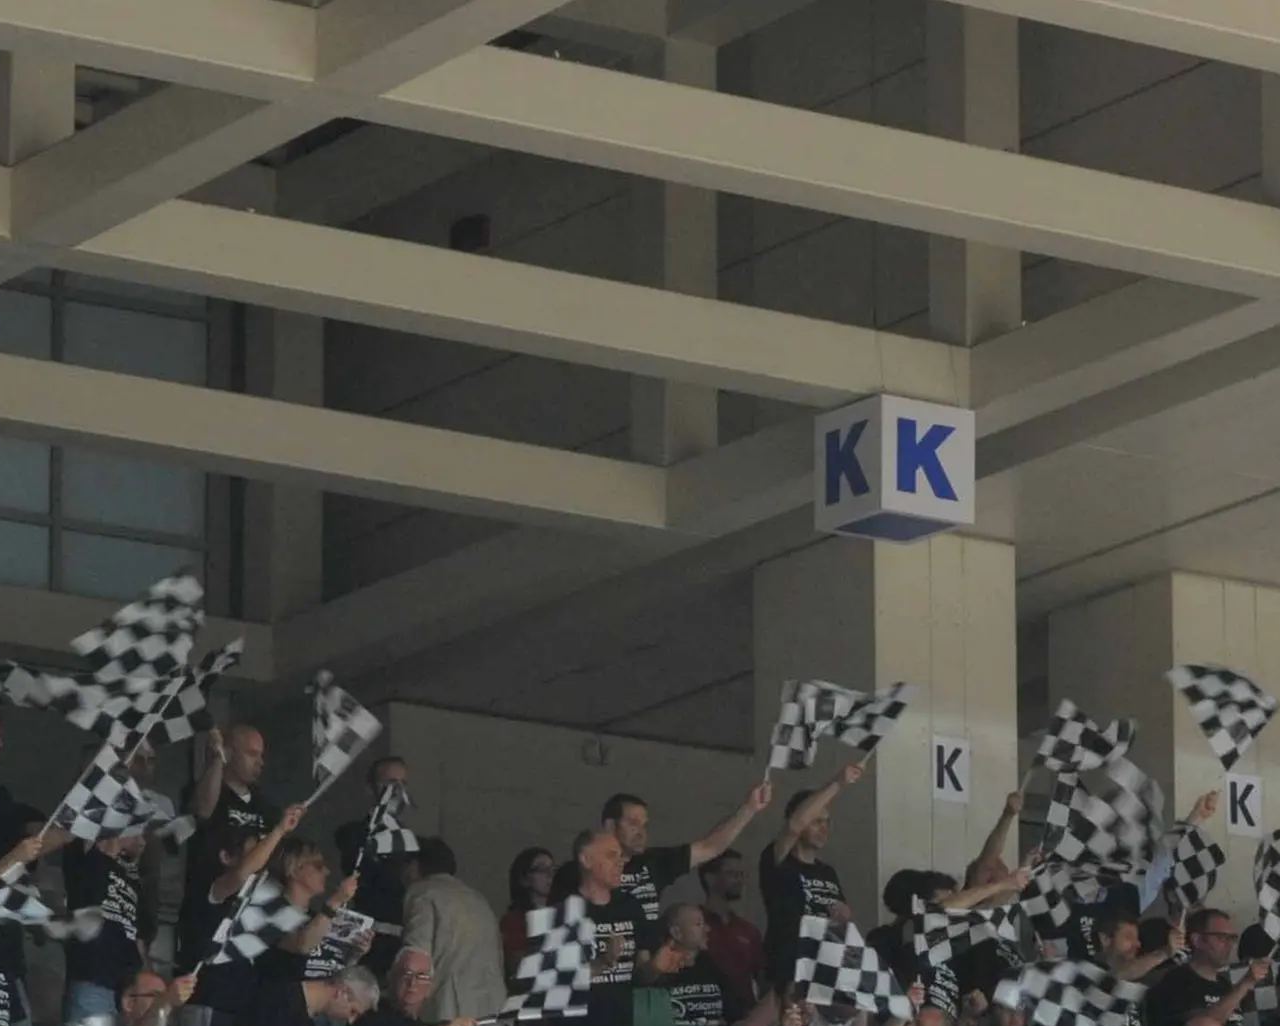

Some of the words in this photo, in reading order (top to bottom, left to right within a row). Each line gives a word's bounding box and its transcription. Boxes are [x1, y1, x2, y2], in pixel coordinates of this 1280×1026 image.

[825, 418, 869, 505] K
[896, 418, 957, 501] K
[936, 745, 963, 792] K
[1230, 781, 1256, 827] K
